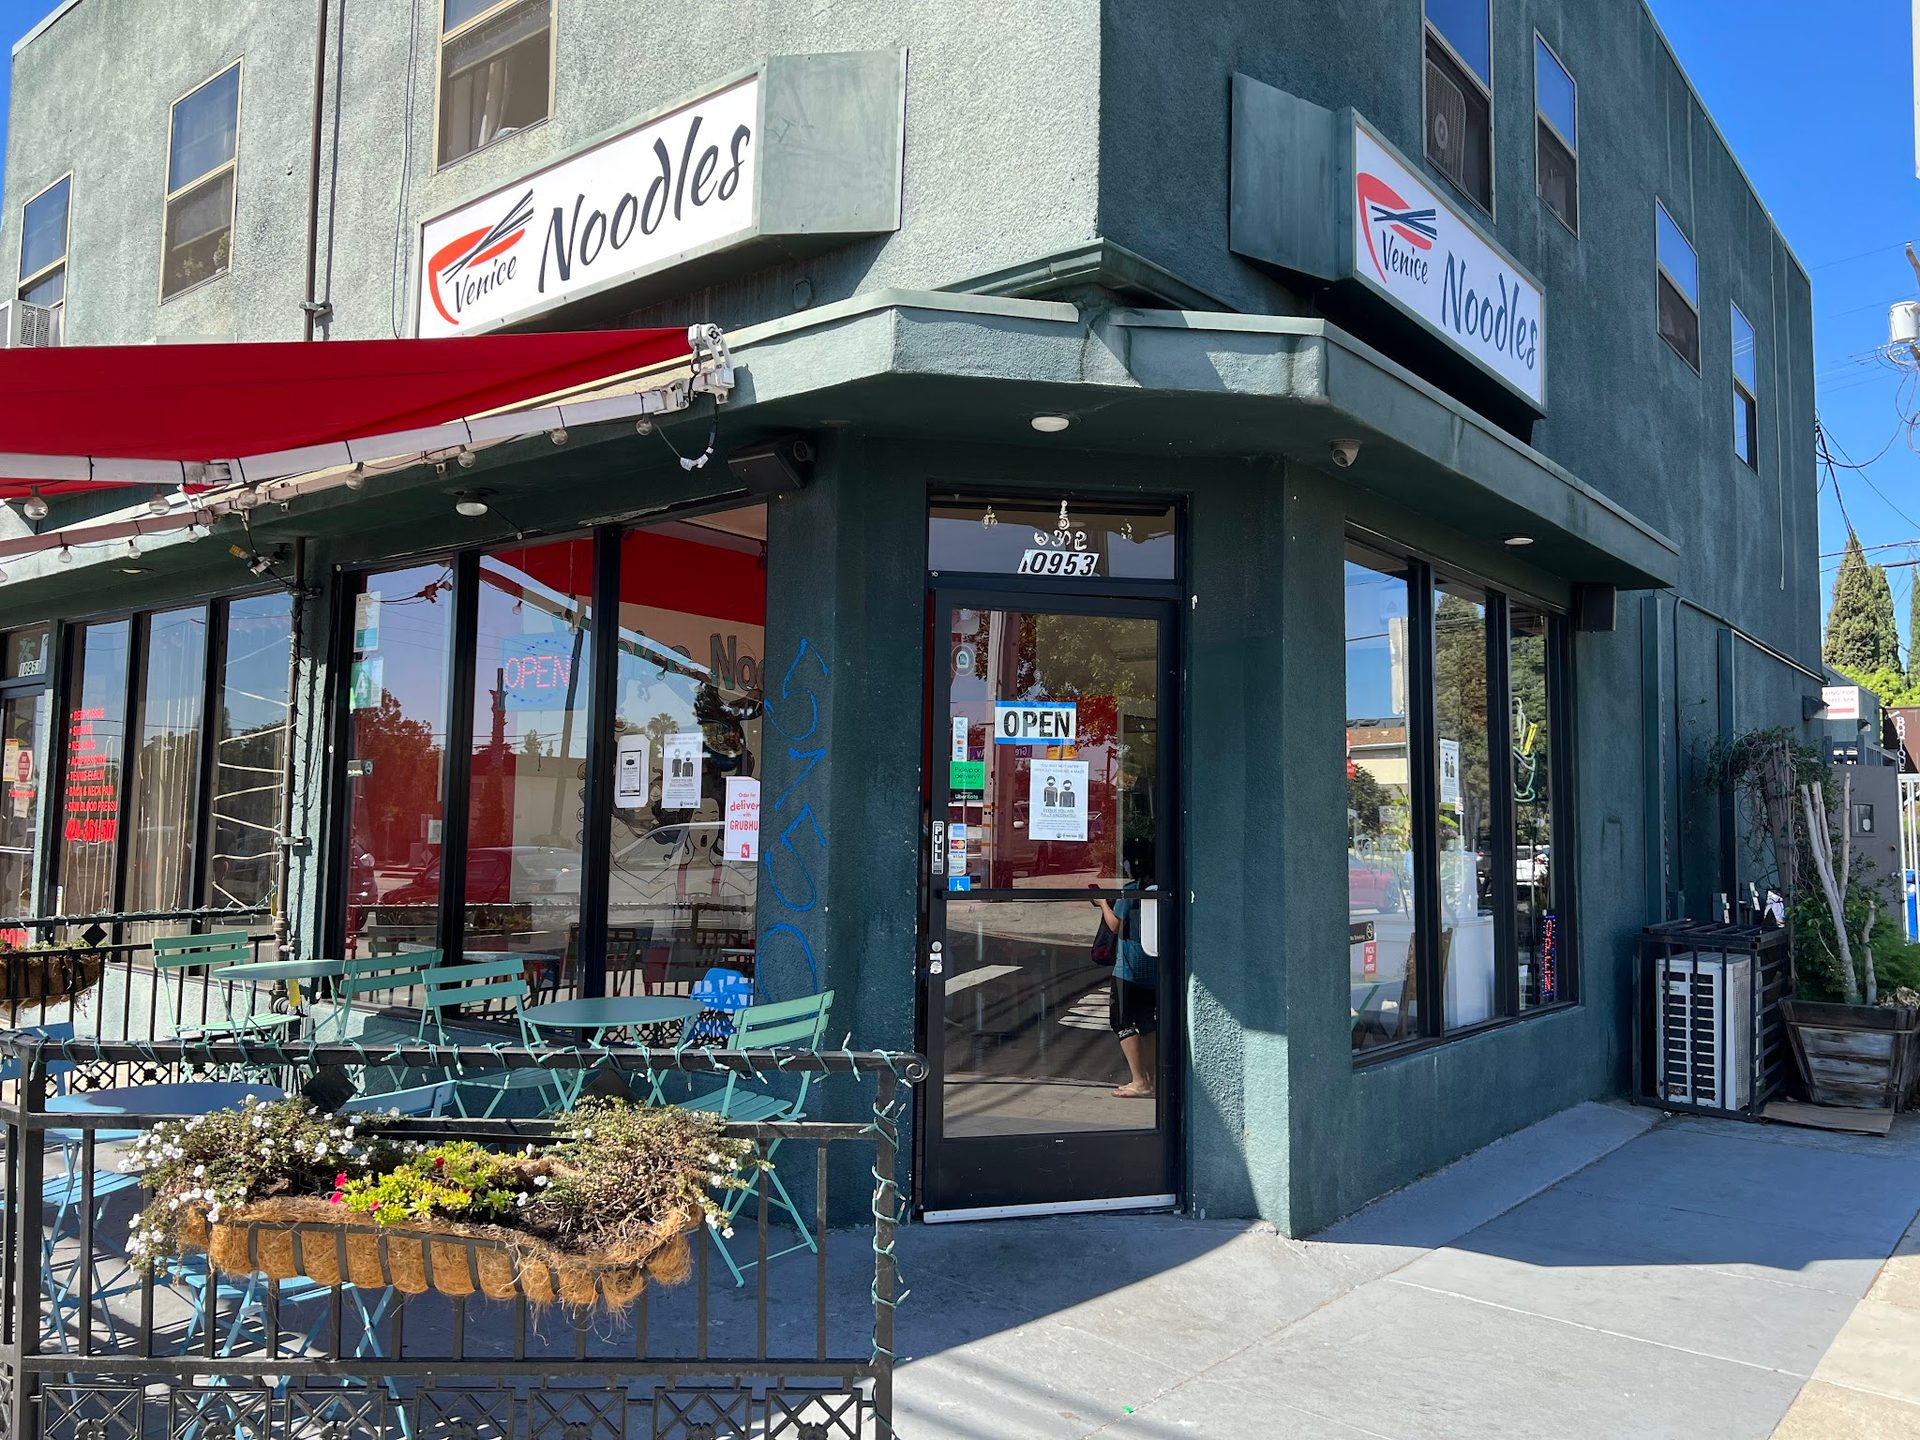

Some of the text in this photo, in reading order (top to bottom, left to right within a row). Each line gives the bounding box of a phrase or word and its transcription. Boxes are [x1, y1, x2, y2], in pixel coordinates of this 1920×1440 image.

[538, 115, 751, 294] Noodles
[1382, 230, 1429, 285] Venice
[454, 252, 517, 314] Venice
[1441, 250, 1538, 370] Noodles
[504, 655, 570, 688] OPEN
[1004, 710, 1070, 737] OPEN
[88, 785, 101, 796] NECK
[730, 800, 760, 811] deliver
[729, 820, 759, 831] GRUBHU
[934, 826, 942, 862] PULL
